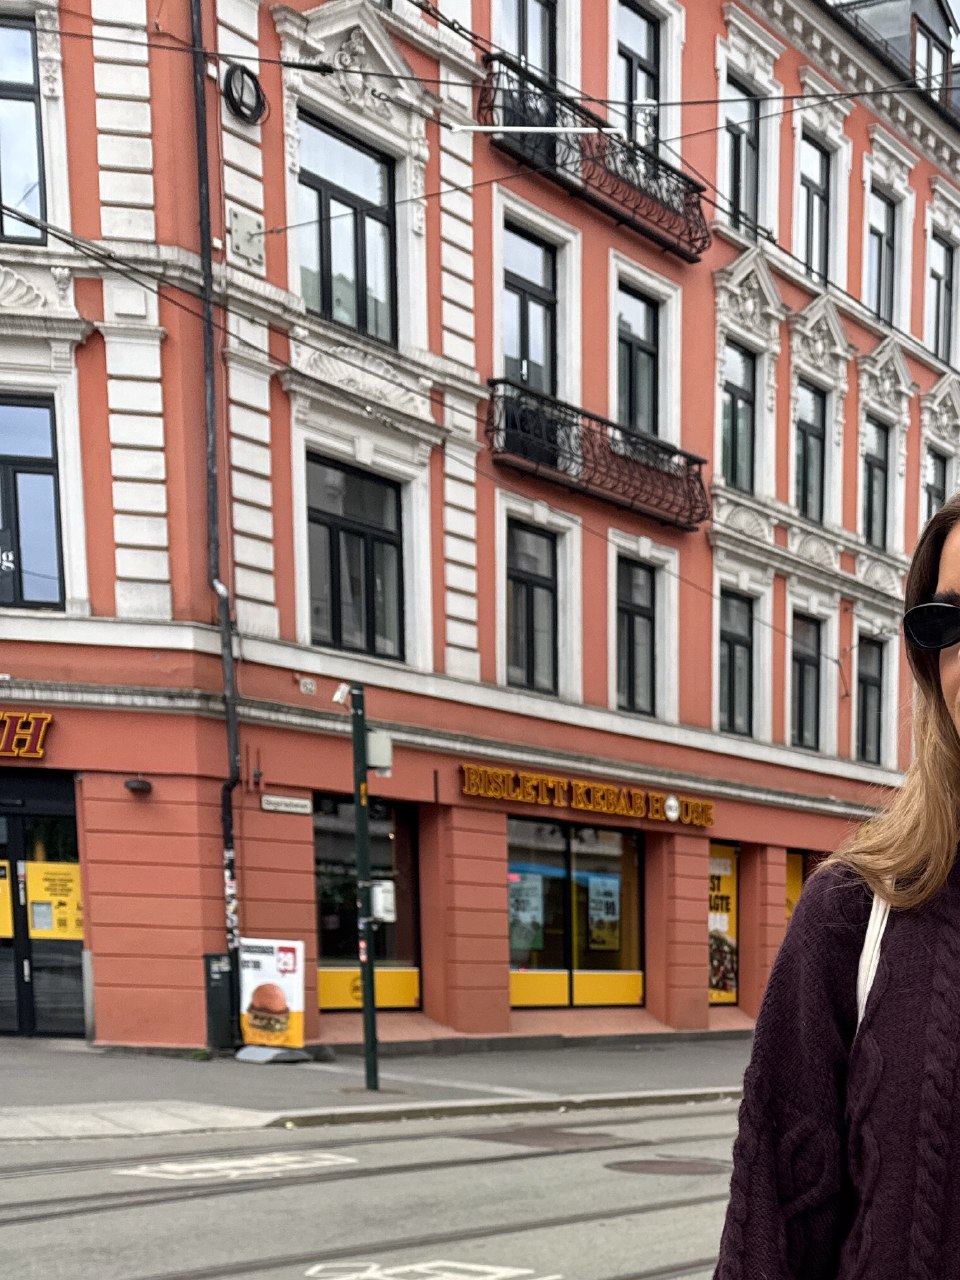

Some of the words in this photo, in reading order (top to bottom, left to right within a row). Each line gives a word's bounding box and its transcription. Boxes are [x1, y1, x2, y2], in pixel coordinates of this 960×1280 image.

[0, 711, 52, 758] H
[462, 763, 568, 808] BISLETT
[571, 779, 646, 818] KEBAB
